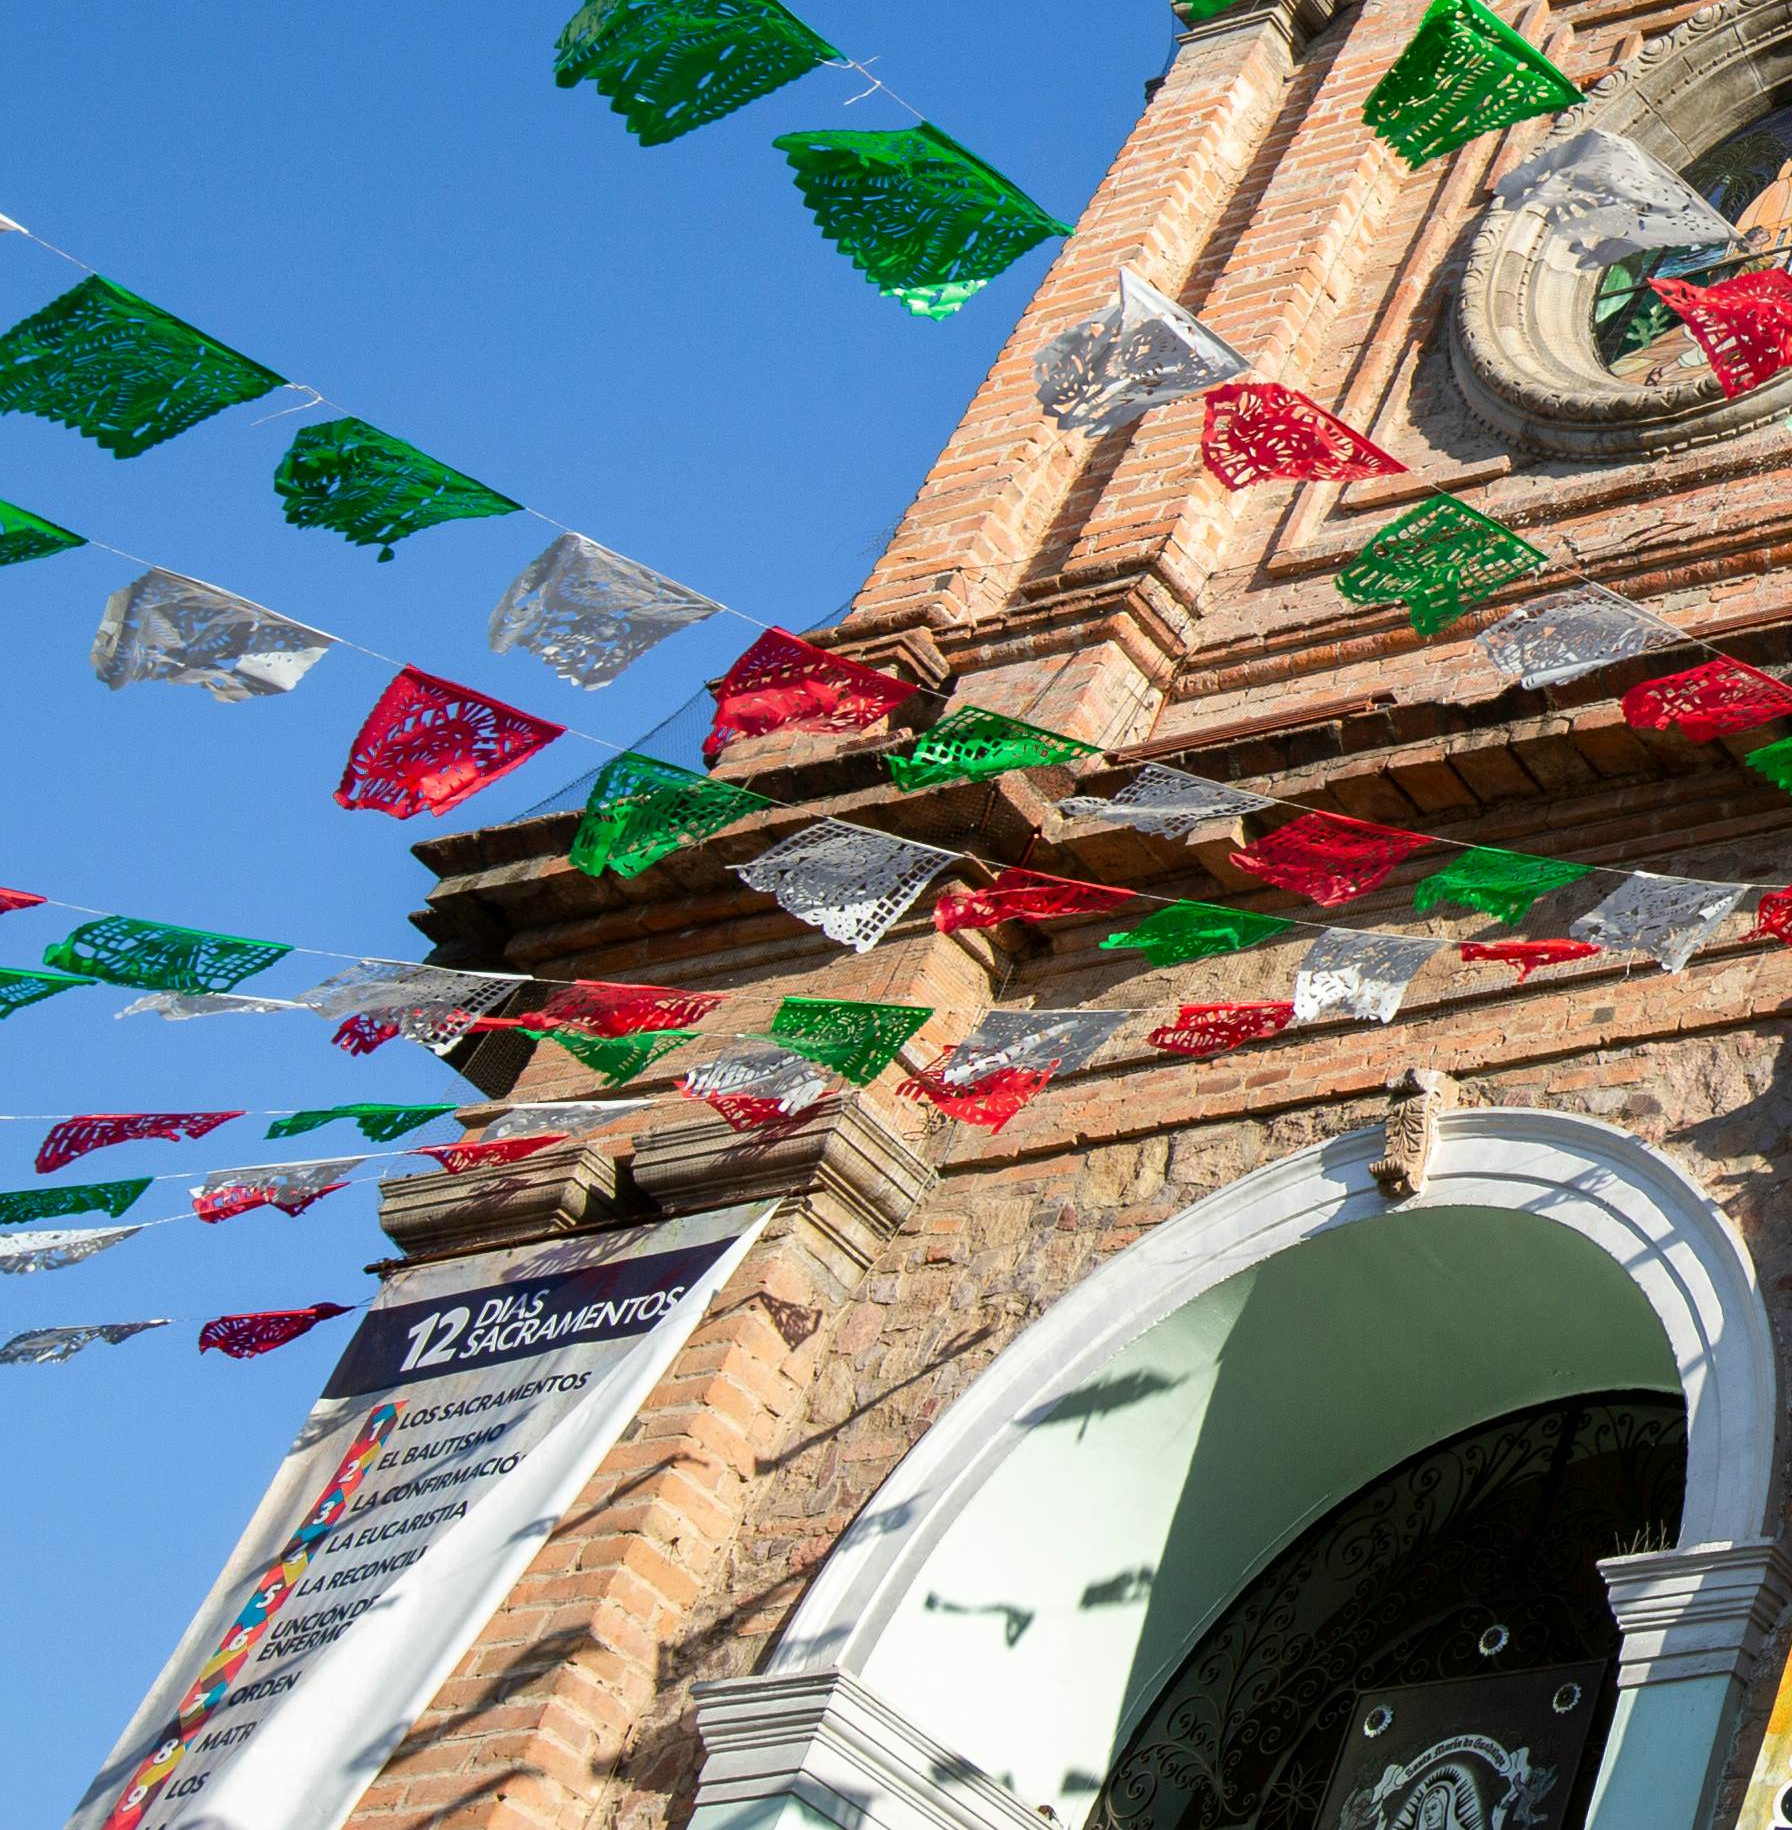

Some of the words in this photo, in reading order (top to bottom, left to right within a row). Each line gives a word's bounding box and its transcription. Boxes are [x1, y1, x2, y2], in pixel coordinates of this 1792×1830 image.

[400, 1307, 471, 1372] 12
[473, 1289, 550, 1330] DIAS
[459, 1286, 686, 1359] SACRAMENTOS
[368, 1419, 387, 1442] 1
[397, 1405, 441, 1431] LOS
[438, 1371, 592, 1423] SACRAMENTOS
[339, 1459, 362, 1484] 2
[376, 1451, 399, 1472] EL
[401, 1423, 508, 1467] BAUTISMO
[312, 1500, 335, 1526] 3
[350, 1491, 377, 1513] LA
[380, 1451, 528, 1503] CONFIRMACIÓ
[325, 1534, 353, 1555] LA
[355, 1500, 468, 1548] EUCARISTIA
[255, 1583, 283, 1609] 5
[295, 1578, 323, 1598] LA
[228, 1626, 254, 1652] 6
[270, 1602, 354, 1640] UNCIÓN
[228, 1672, 302, 1708] ORDEN
[152, 1737, 180, 1765] 8
[195, 1719, 264, 1754] MATR
[121, 1785, 148, 1812] 9
[164, 1772, 211, 1801] LOS
